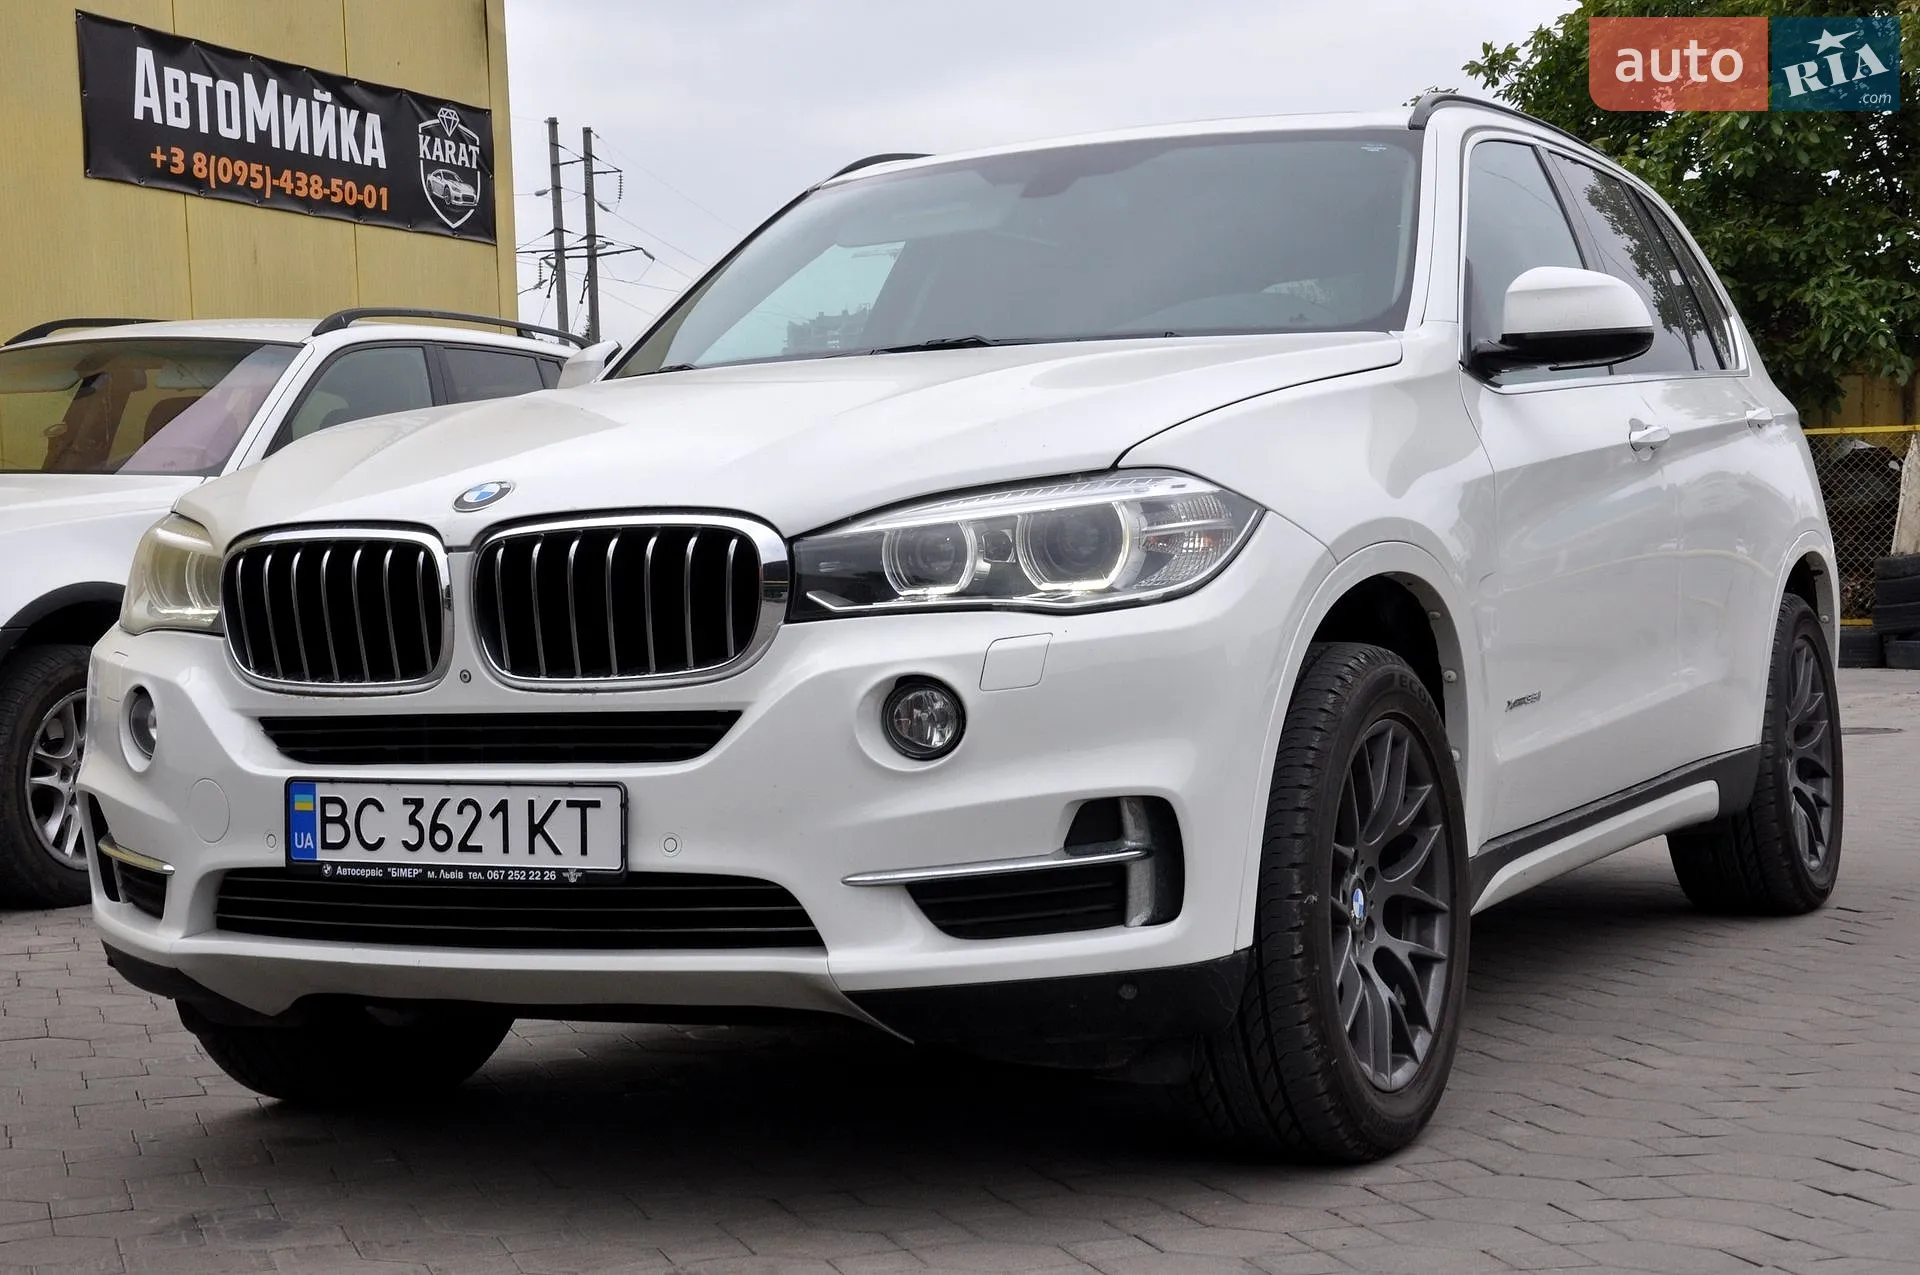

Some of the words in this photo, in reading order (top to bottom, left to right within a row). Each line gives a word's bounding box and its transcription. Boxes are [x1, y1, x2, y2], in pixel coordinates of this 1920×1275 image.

[419, 135, 480, 169] KARAT
[193, 150, 389, 211] 8(095)-438-50-01
[294, 832, 314, 849] UA
[401, 797, 509, 854] 3621
[336, 866, 383, 877] Автосервіс
[439, 869, 464, 880] Львів
[468, 871, 485, 880] тел.
[486, 870, 505, 880] 067
[507, 870, 526, 880] 252
[528, 871, 541, 880] 22
[543, 871, 556, 880] 26
